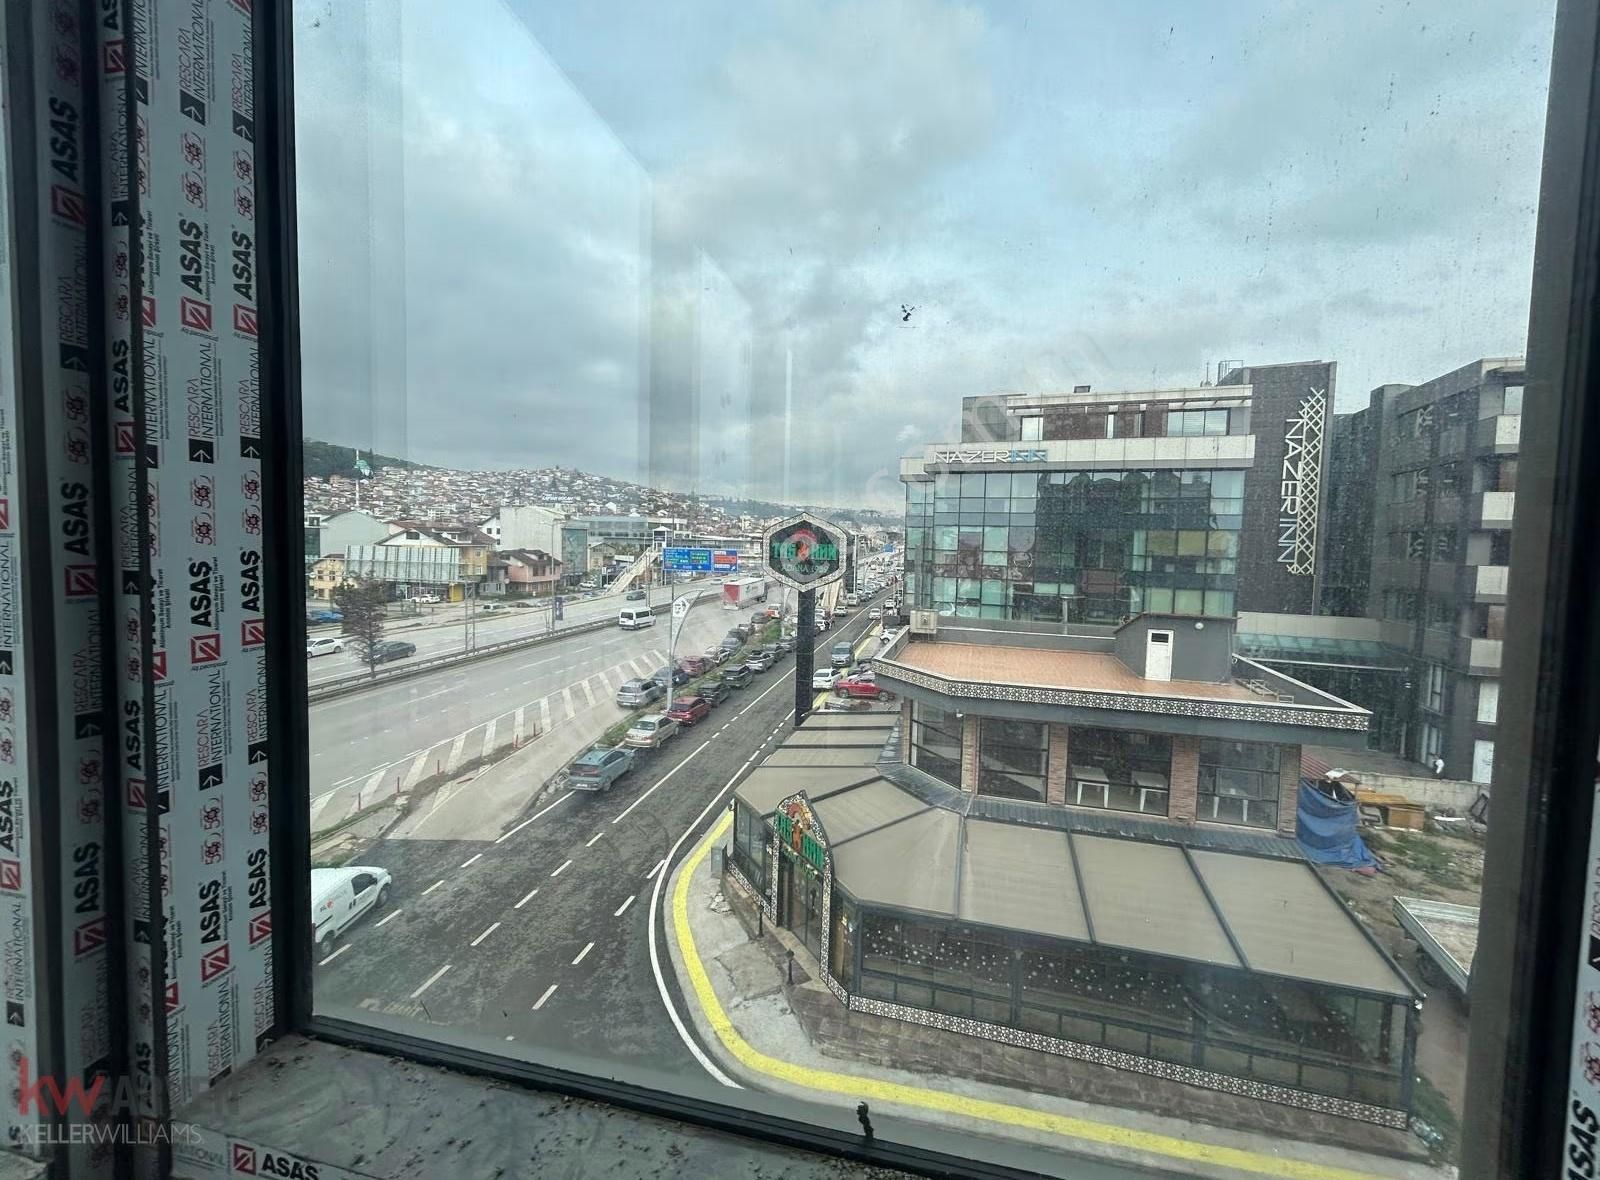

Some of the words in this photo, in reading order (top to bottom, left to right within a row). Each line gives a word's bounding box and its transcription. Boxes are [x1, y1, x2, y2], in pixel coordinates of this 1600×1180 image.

[178, 28, 191, 92] RESCARA
[232, 52, 243, 111] RESCARA
[187, 378, 200, 438] RESCARA
[200, 342, 215, 439] INTERNATIONAL
[239, 379, 250, 435] RESCARA
[1280, 419, 1306, 515] NAZER
[154, 689, 171, 793] INTERNATIONAL
[197, 708, 210, 767] RESCARA
[209, 669, 223, 763] INTERNATIONAL
